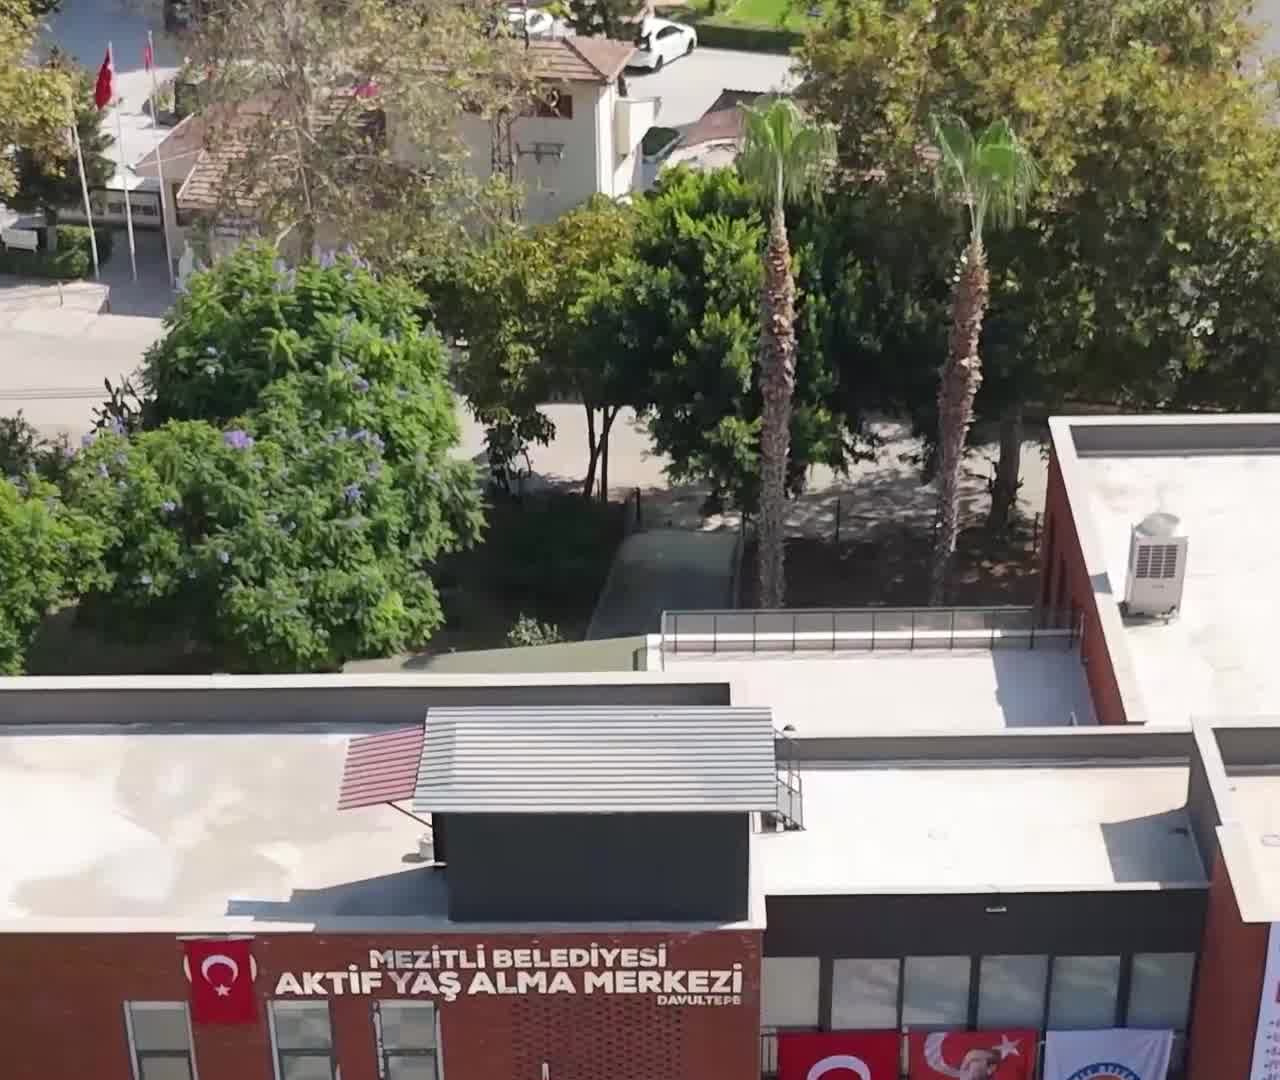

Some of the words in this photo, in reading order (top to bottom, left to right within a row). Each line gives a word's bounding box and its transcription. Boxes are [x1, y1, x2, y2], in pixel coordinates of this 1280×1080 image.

[370, 944, 485, 969] MEZİTLİ
[493, 942, 666, 968] BELEDİYESİ
[275, 963, 382, 995] AKTİF
[387, 971, 461, 1002] YAŞ
[467, 971, 576, 995] ALMA
[584, 963, 743, 994] MERKEZİ
[657, 995, 742, 1006] DAVULTEPE
